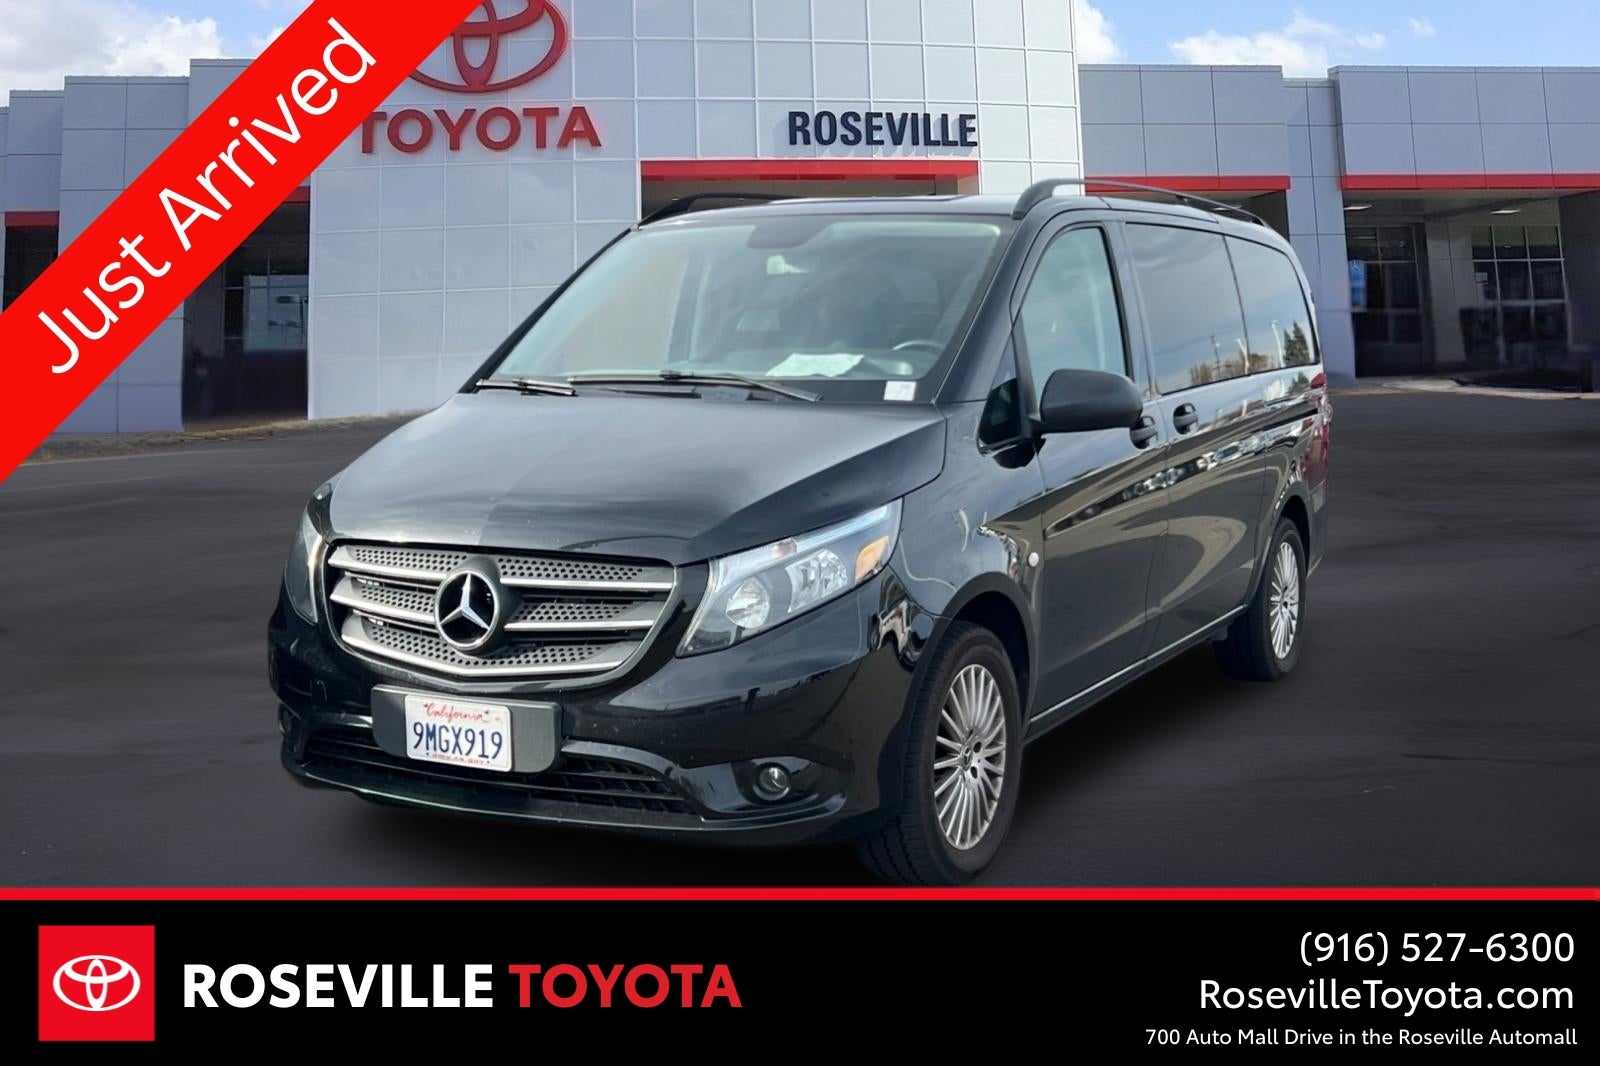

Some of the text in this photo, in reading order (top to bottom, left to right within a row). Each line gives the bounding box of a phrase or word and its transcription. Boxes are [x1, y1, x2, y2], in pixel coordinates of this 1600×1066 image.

[361, 106, 602, 154] TOYOTA
[788, 110, 978, 147] ROSEVILLE
[424, 702, 489, 723] California
[413, 721, 503, 760] 9MGX919
